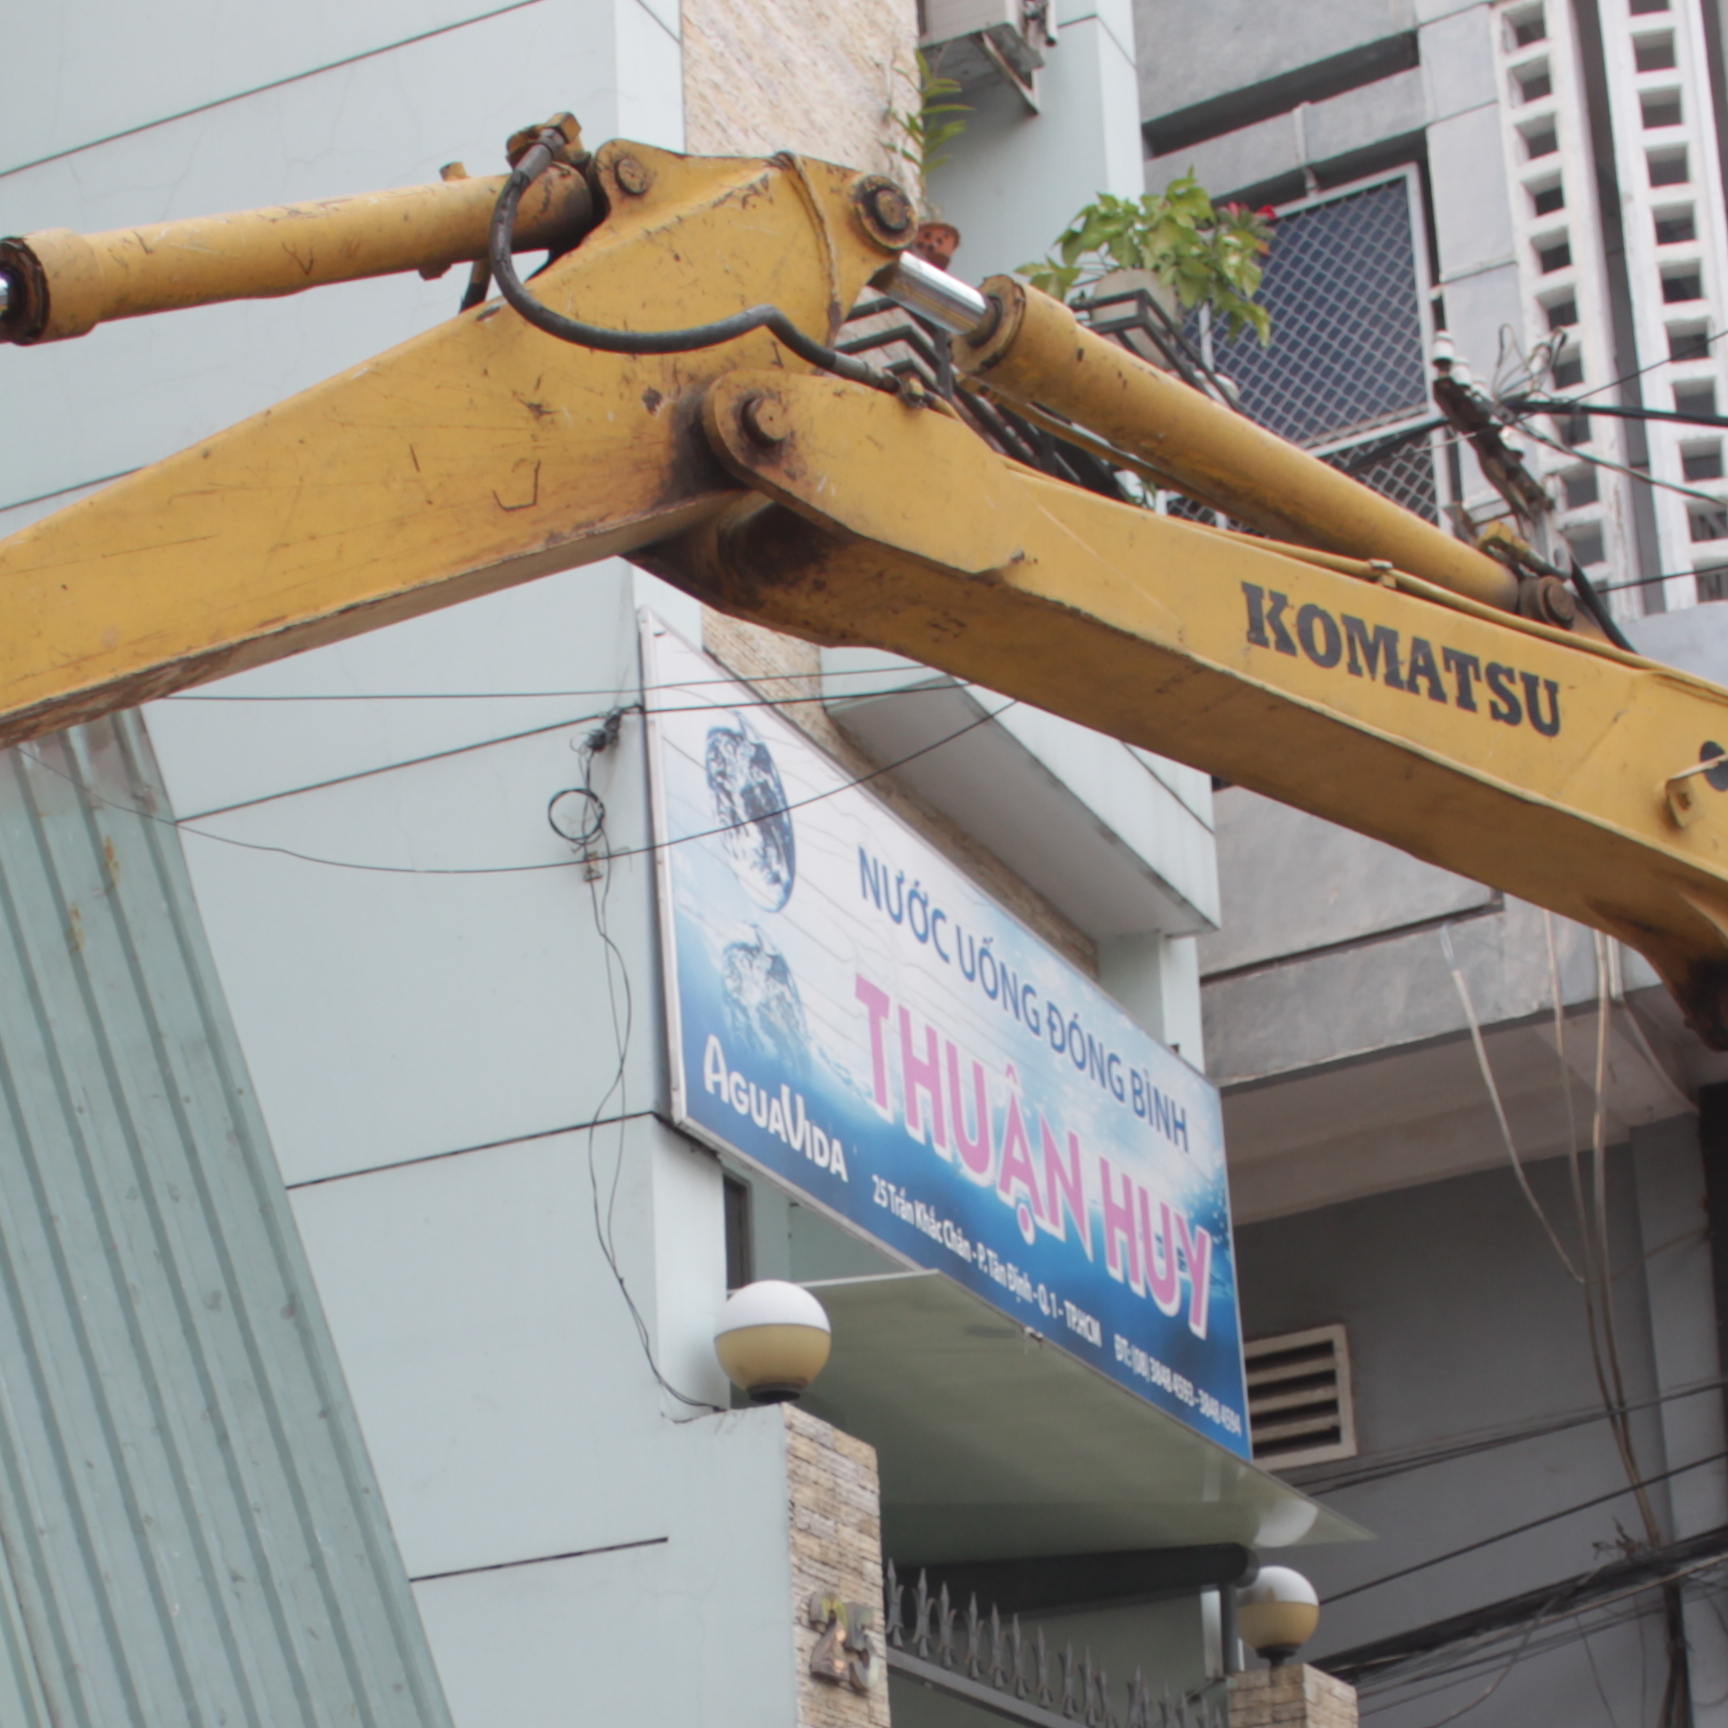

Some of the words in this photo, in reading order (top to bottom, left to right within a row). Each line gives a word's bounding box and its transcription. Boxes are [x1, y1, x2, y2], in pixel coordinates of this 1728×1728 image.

[1241, 580, 1561, 738] KOMATSU
[858, 845, 951, 964] NƯỚC
[955, 924, 1042, 1038] UỐNG
[1046, 1000, 1125, 1104] ĐÓNG
[1129, 1067, 1189, 1154] BÌNH
[855, 973, 1092, 1262] THUẬN
[1099, 1156, 1212, 1341] HUY
[872, 1174, 888, 1208] 25
